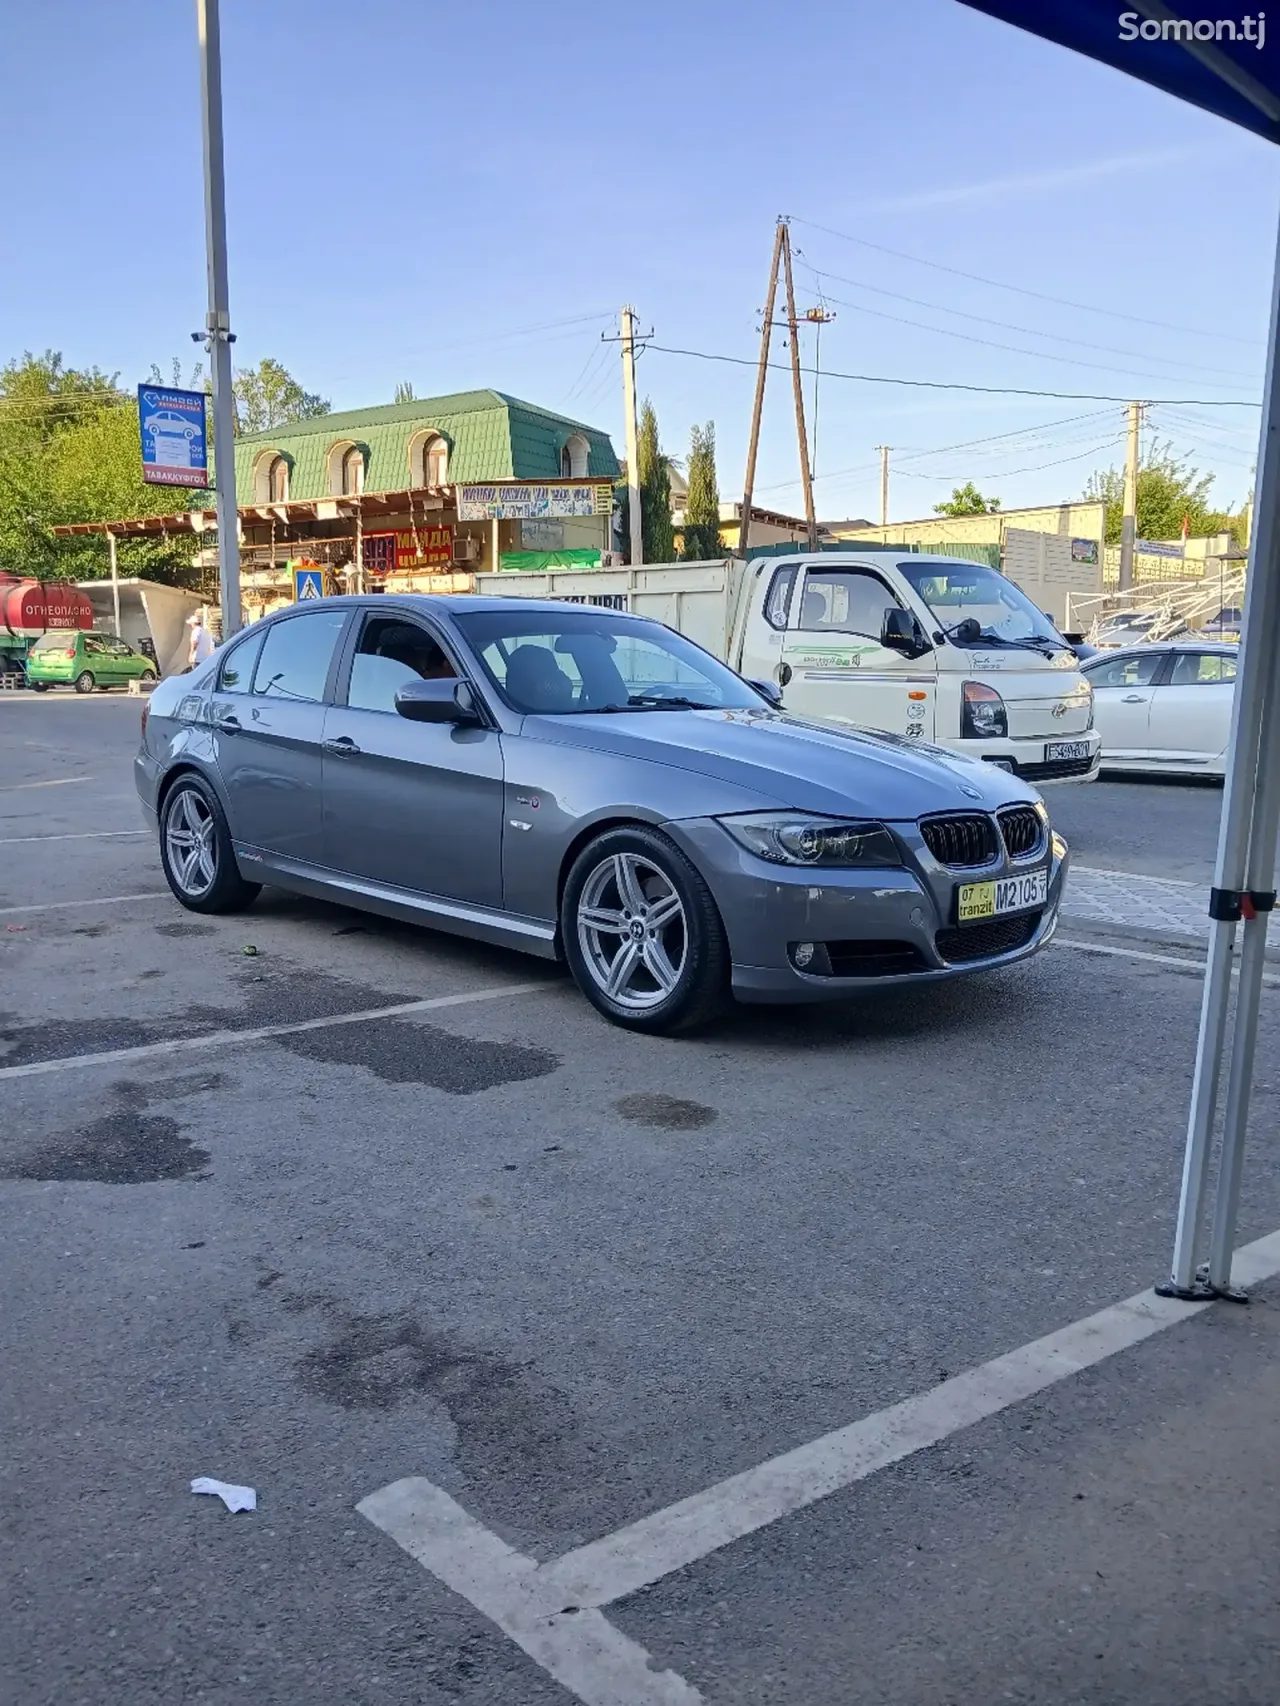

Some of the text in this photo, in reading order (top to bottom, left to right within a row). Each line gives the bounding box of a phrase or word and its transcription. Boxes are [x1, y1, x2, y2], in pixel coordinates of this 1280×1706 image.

[962, 888, 974, 901] 07
[996, 877, 1038, 910] M2105
[960, 900, 993, 917] tranzit
